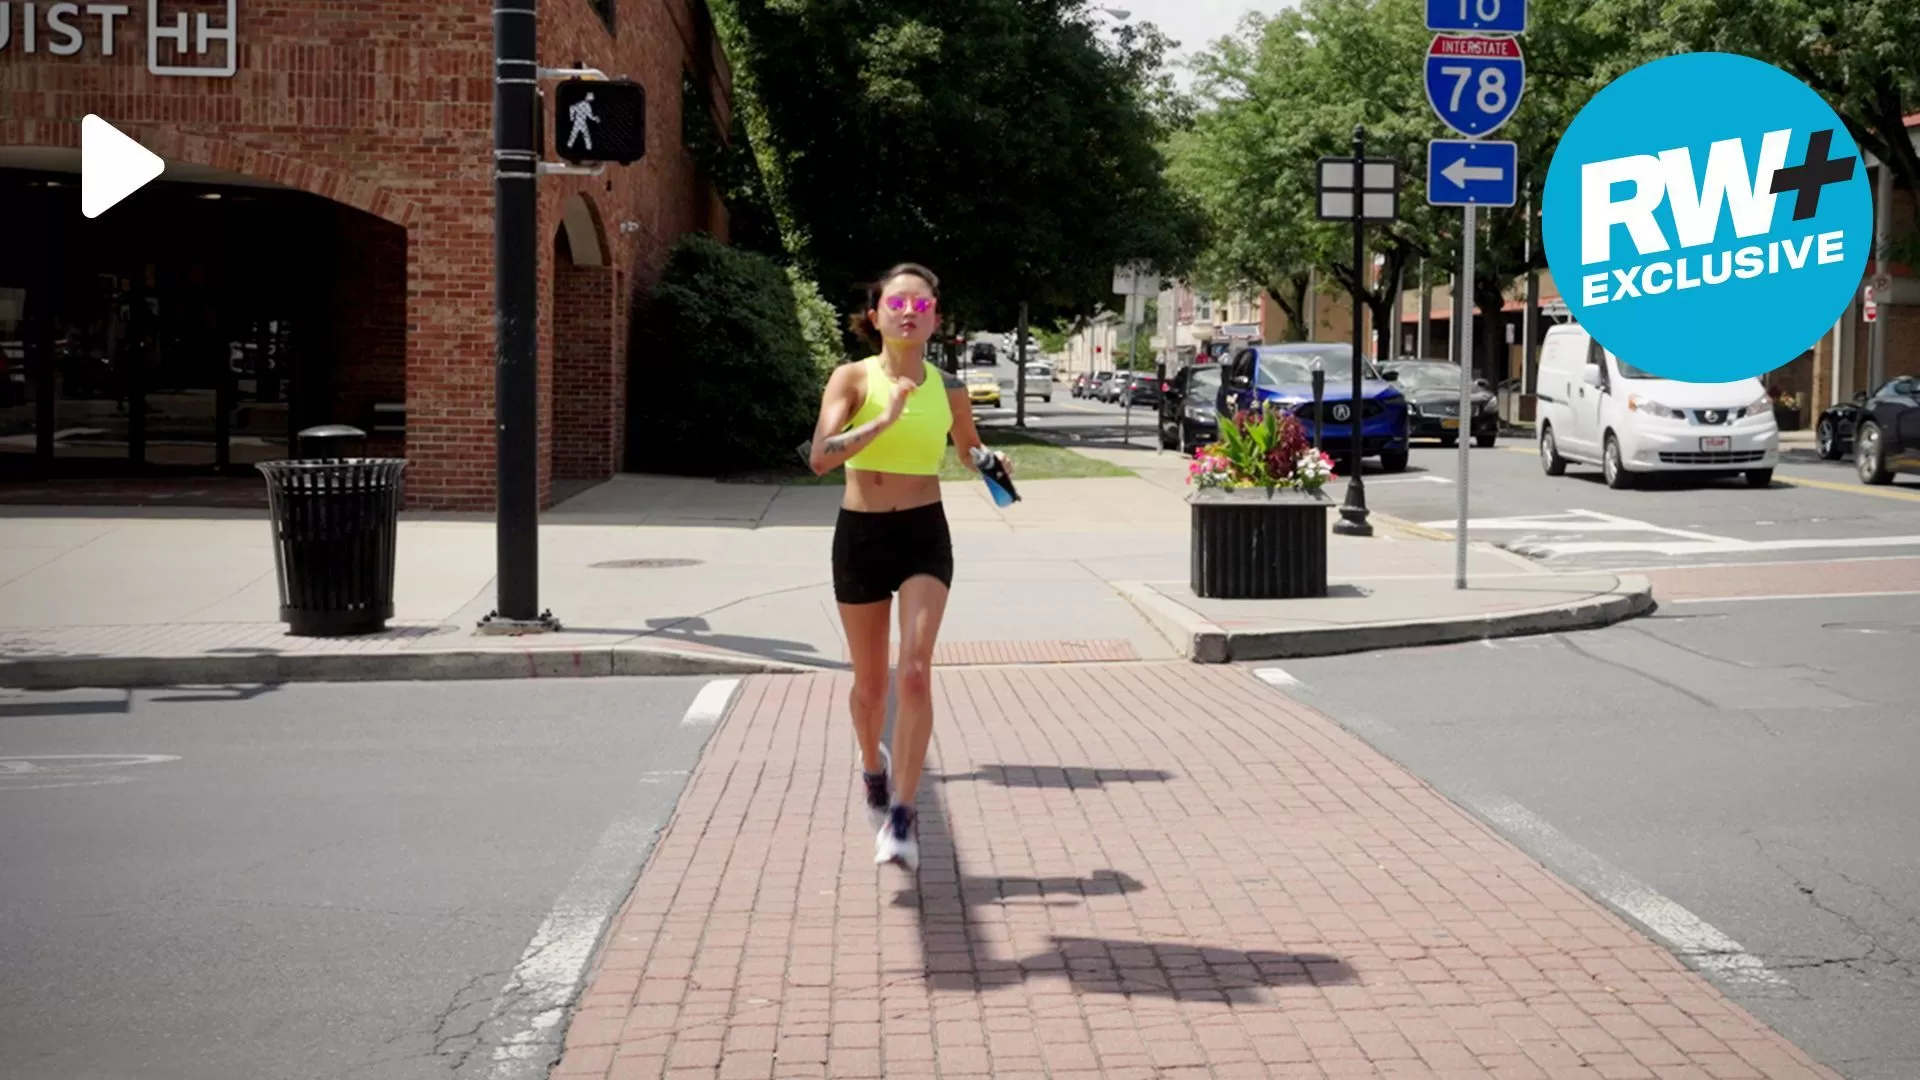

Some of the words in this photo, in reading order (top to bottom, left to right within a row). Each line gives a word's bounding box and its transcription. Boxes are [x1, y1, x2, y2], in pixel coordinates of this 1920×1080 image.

[0, 1, 129, 56] IST
[1441, 40, 1509, 56] INTERSTATE
[1441, 66, 1508, 114] 78
